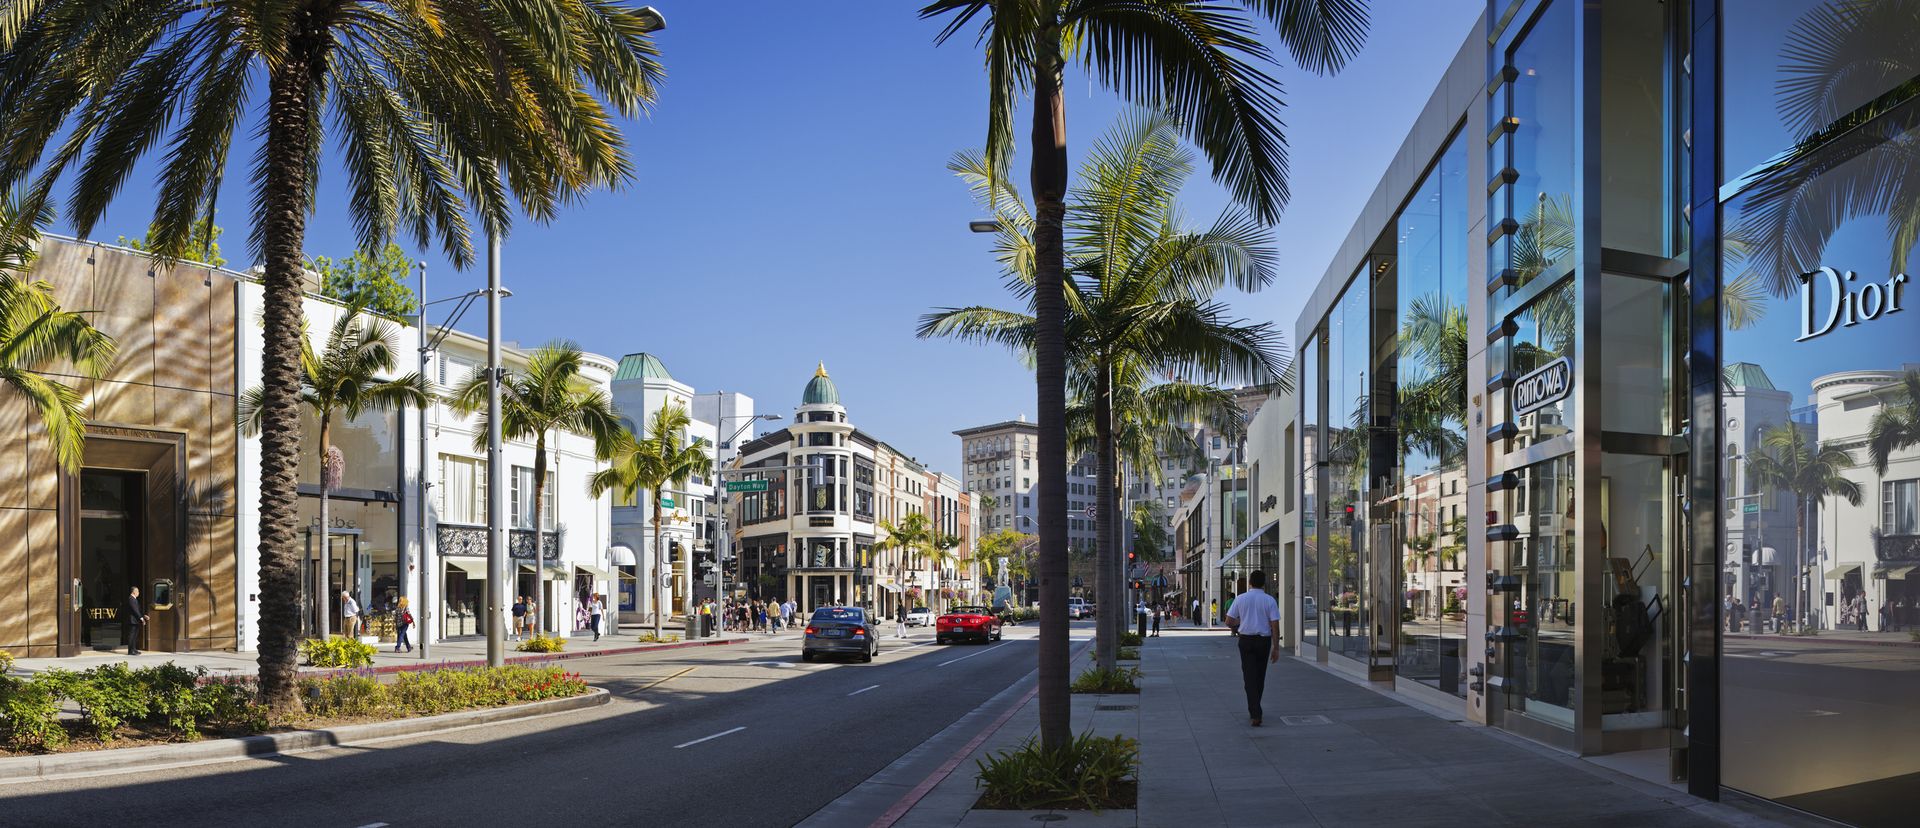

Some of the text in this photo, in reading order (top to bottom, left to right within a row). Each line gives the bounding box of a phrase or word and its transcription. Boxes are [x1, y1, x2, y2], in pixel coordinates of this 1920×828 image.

[1793, 266, 1905, 342] Dior
[1517, 365, 1563, 409] RIMOWA
[311, 515, 357, 529] bbe
